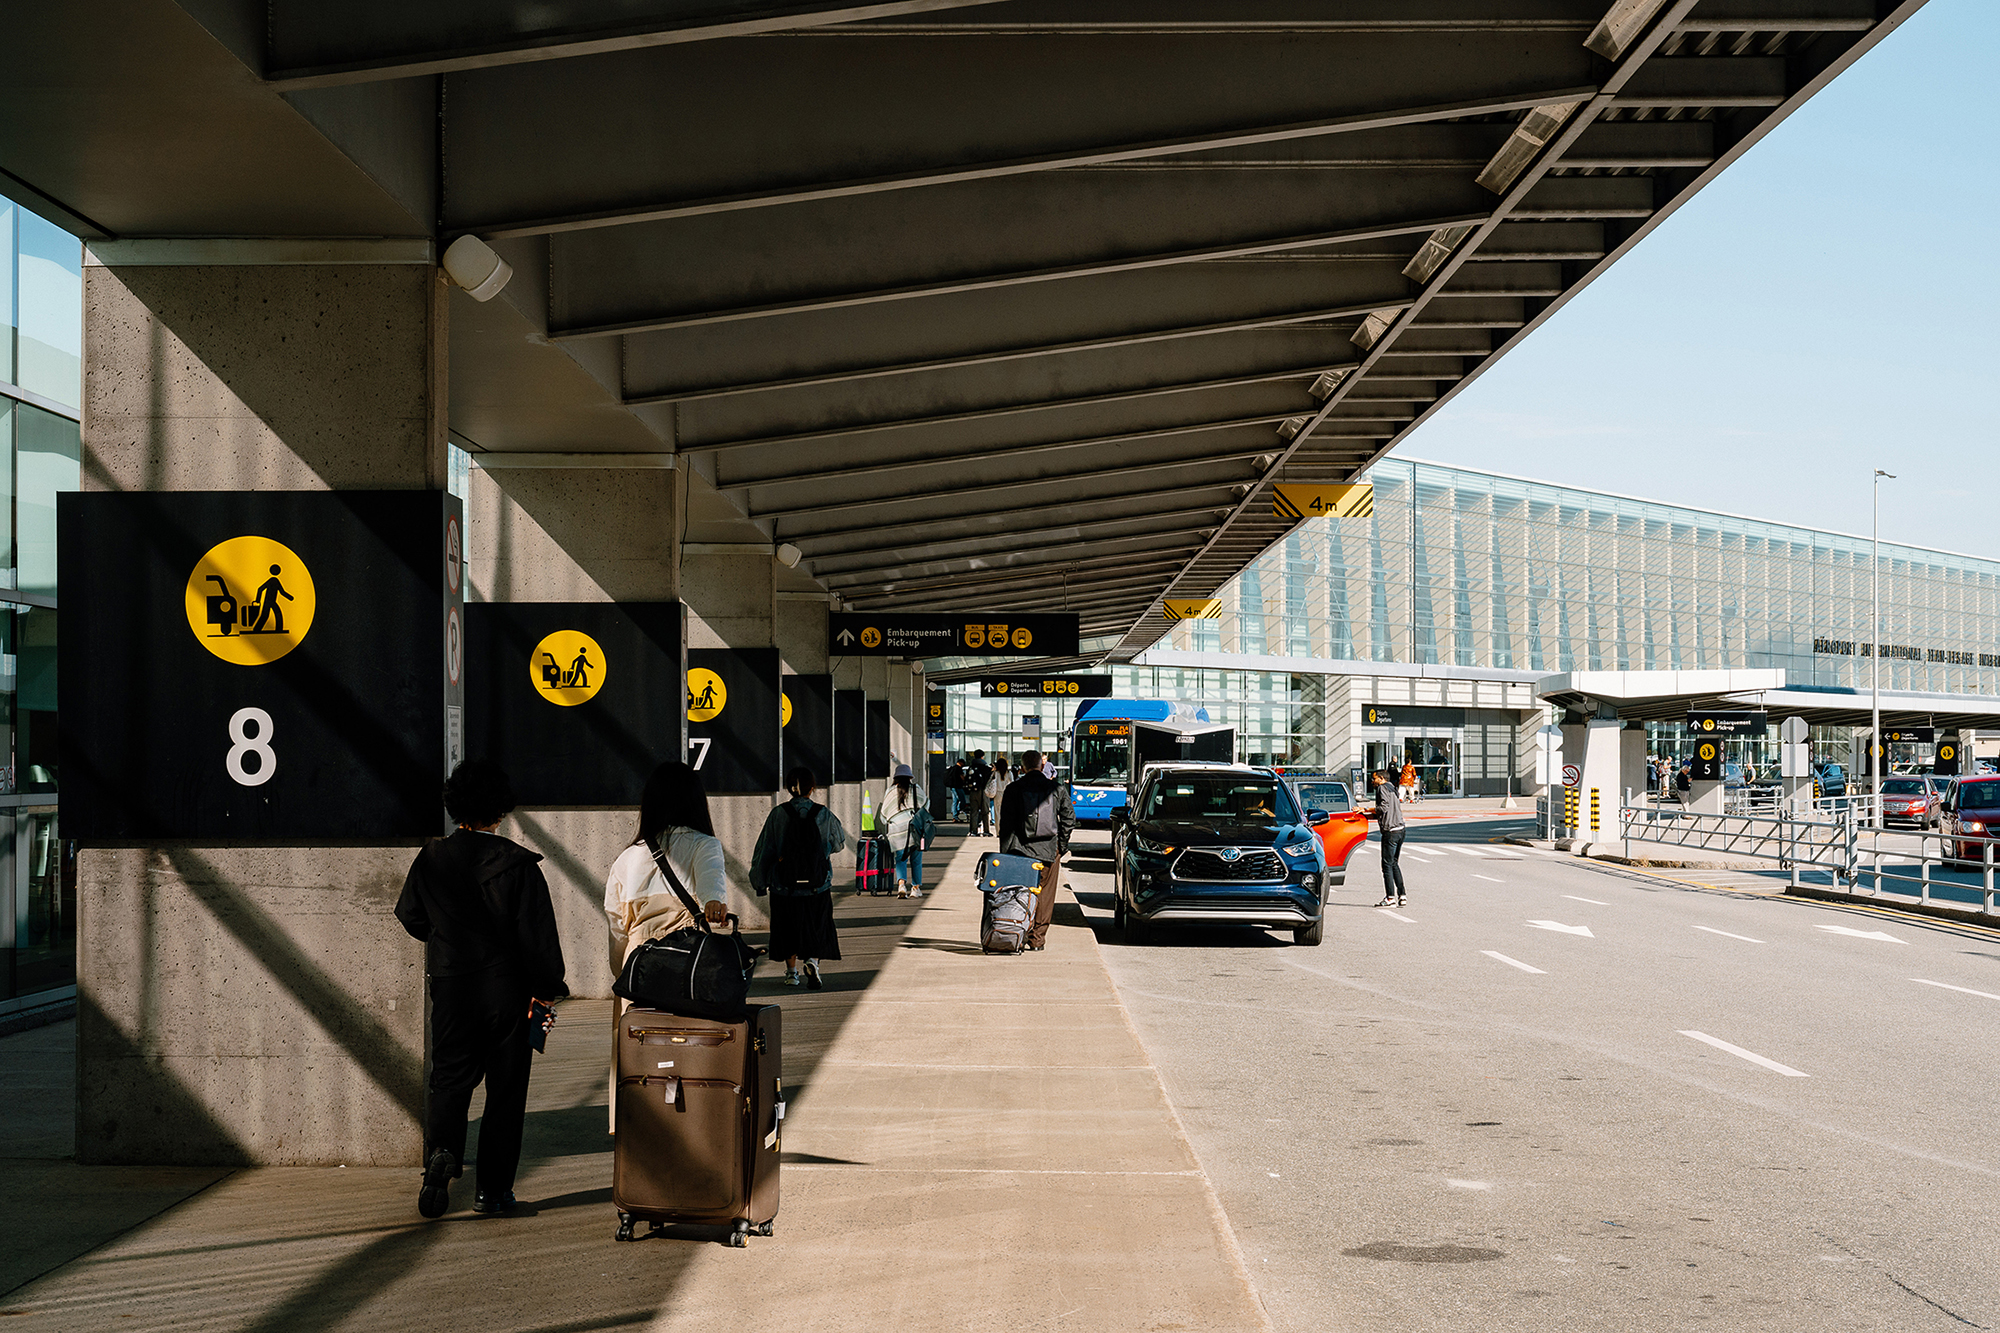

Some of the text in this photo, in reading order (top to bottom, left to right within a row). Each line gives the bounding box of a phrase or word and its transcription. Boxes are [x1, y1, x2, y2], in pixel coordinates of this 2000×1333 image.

[1309, 496, 1338, 511] 4 m
[1184, 606, 1193, 616] 4
[887, 628, 951, 638] Embarquement
[887, 638, 920, 648] Pick-up
[1861, 643, 1921, 661] INTRNATIONAL
[1089, 724, 1098, 734] 80
[226, 707, 277, 787] 8
[688, 738, 712, 771] 7
[1704, 764, 1711, 774] 5
